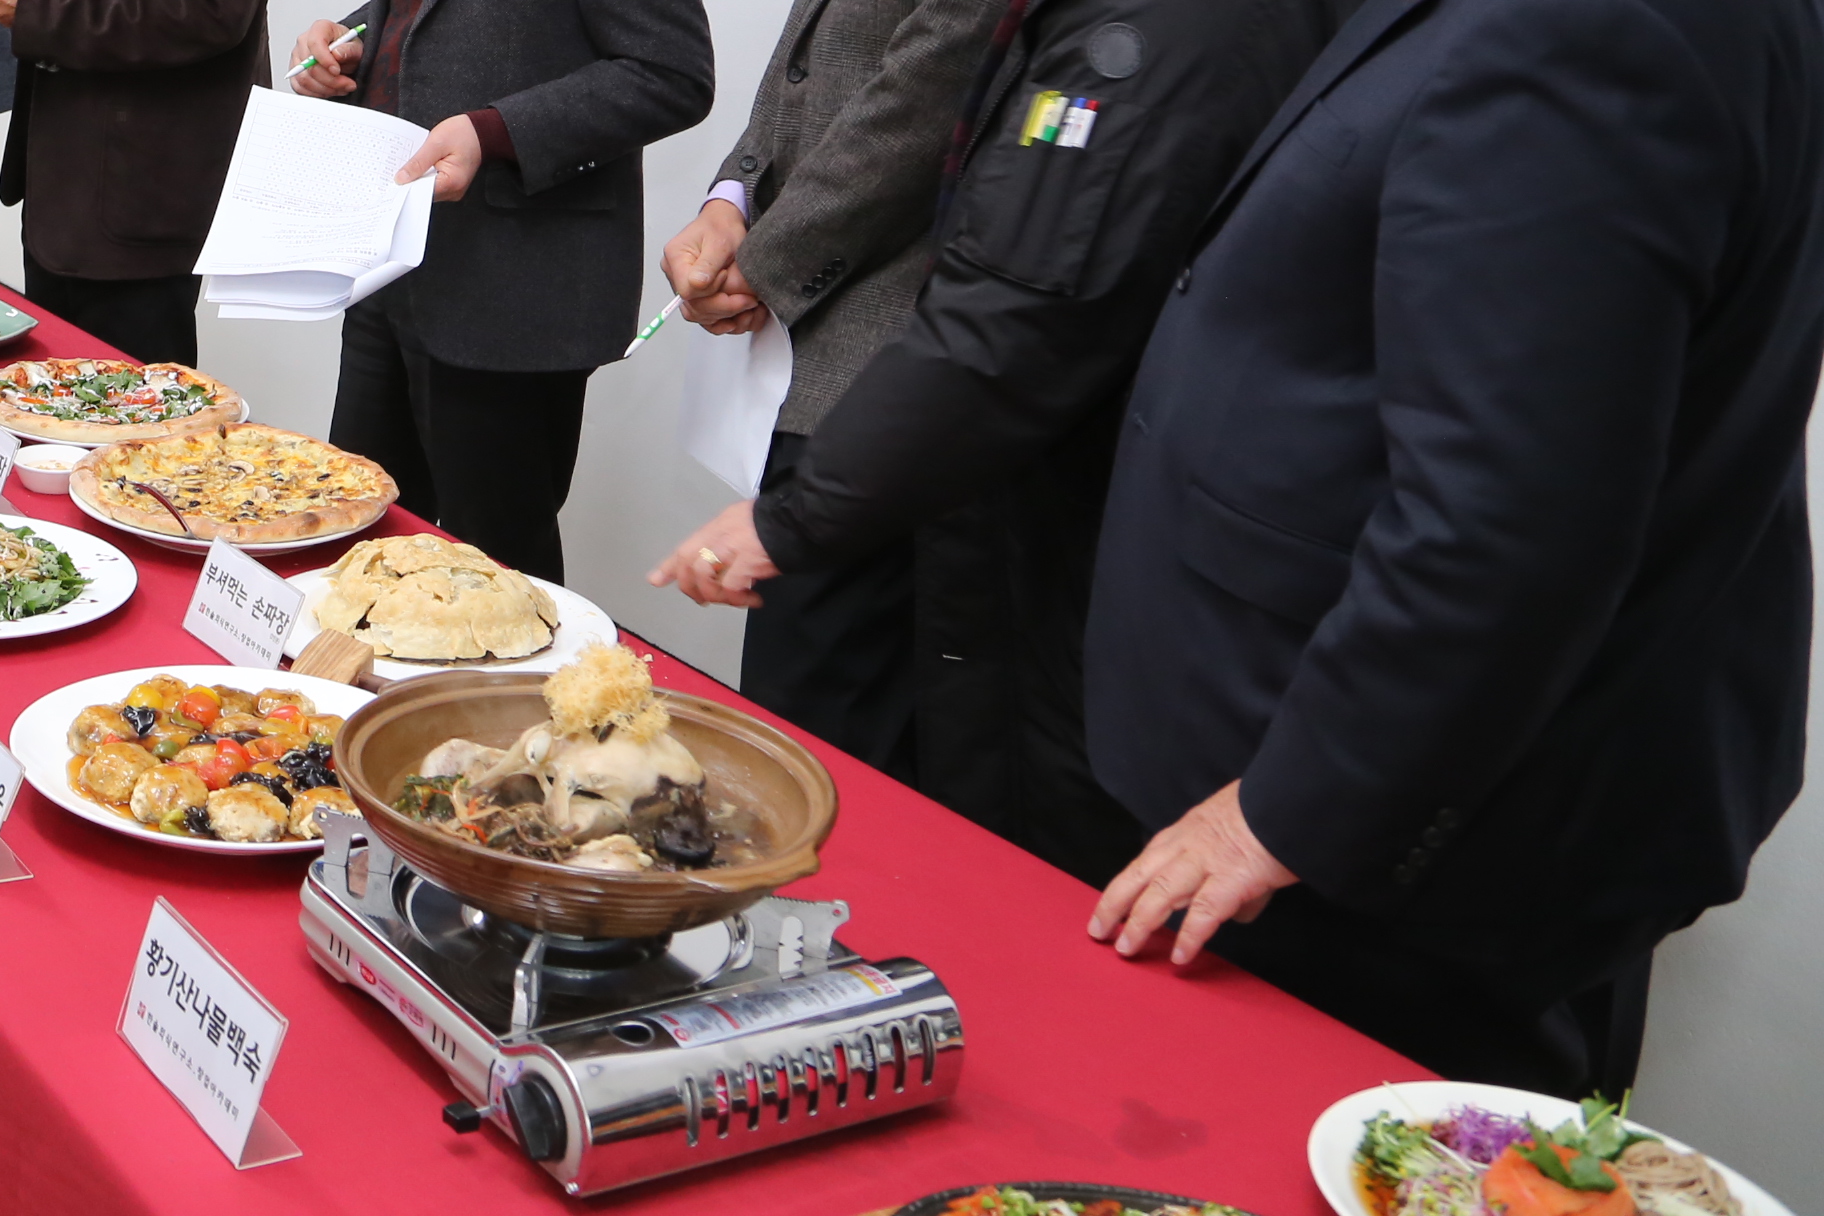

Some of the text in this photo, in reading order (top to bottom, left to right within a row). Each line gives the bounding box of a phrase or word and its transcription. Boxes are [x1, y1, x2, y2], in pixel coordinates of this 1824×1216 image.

[205, 563, 290, 635] 부셔먹는 손짜장
[146, 938, 262, 1084] 황기산나물백숙
